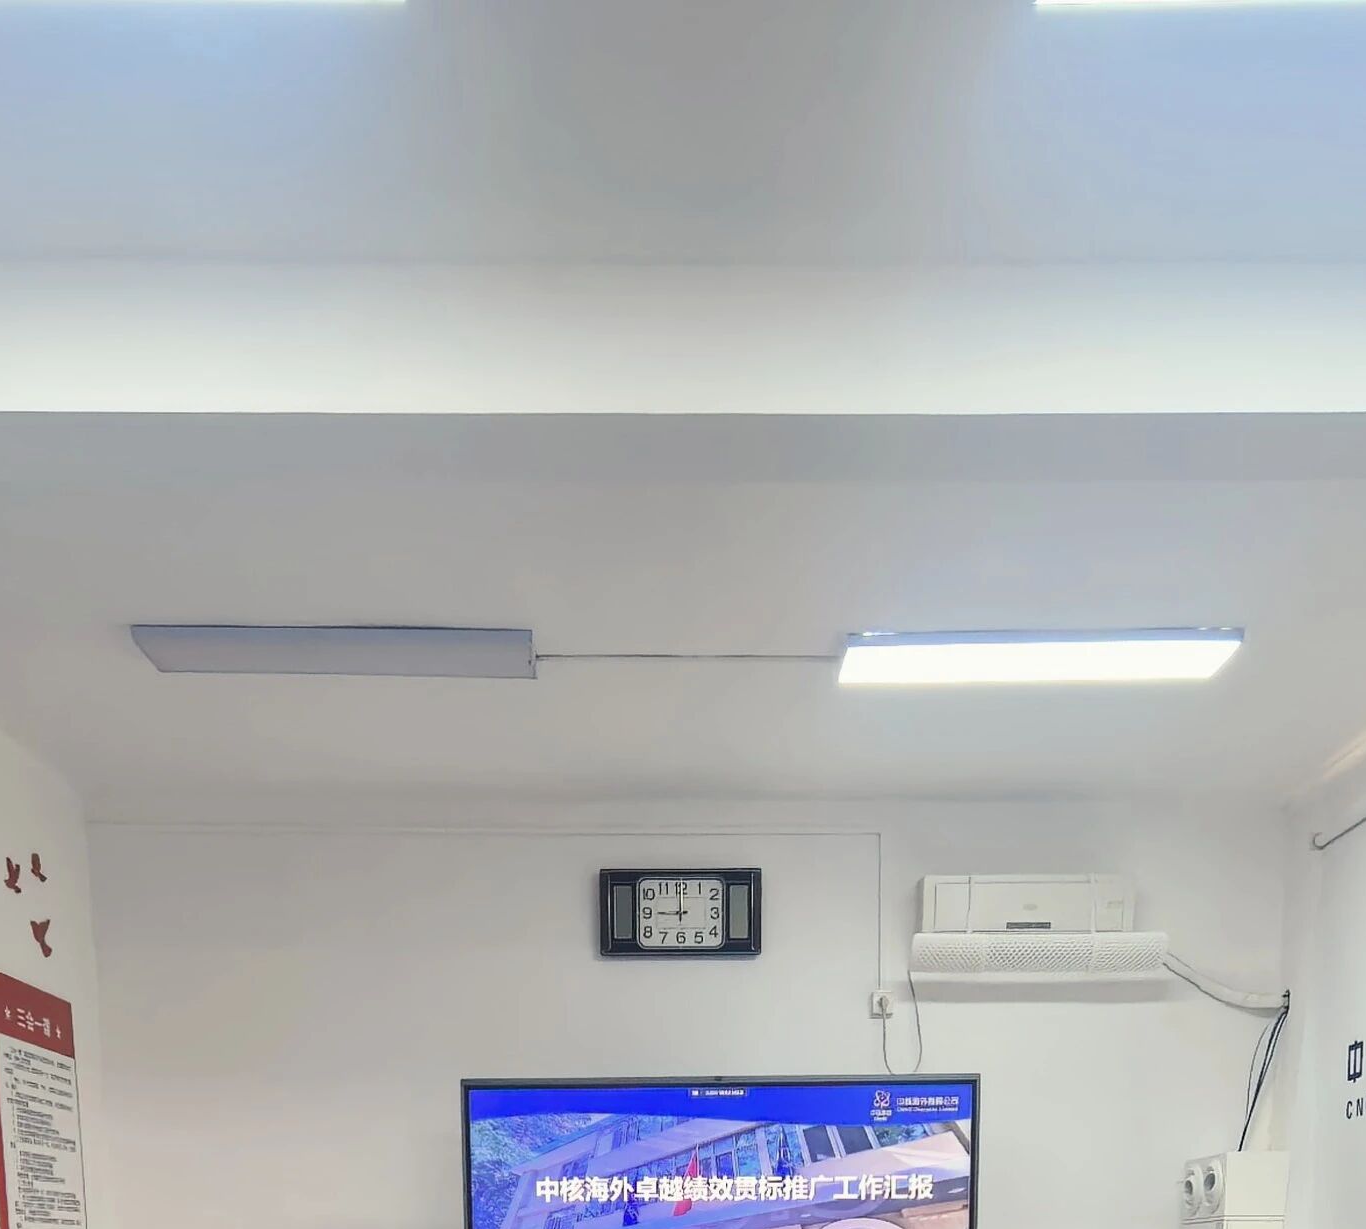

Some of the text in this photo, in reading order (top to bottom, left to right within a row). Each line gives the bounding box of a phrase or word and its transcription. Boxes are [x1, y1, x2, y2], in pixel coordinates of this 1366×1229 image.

[643, 888, 656, 901] 10
[658, 881, 669, 896] 11
[698, 882, 703, 895] 1
[709, 888, 720, 901] 2
[642, 906, 653, 920] 9
[710, 907, 720, 920] 3
[643, 925, 653, 939] 8
[659, 931, 669, 944] 7
[676, 931, 686, 944] 6
[694, 931, 704, 944] 5
[709, 925, 719, 938] 4
[535, 1174, 935, 1203] 中核海外卓越绩效贯标推广工作汇报
